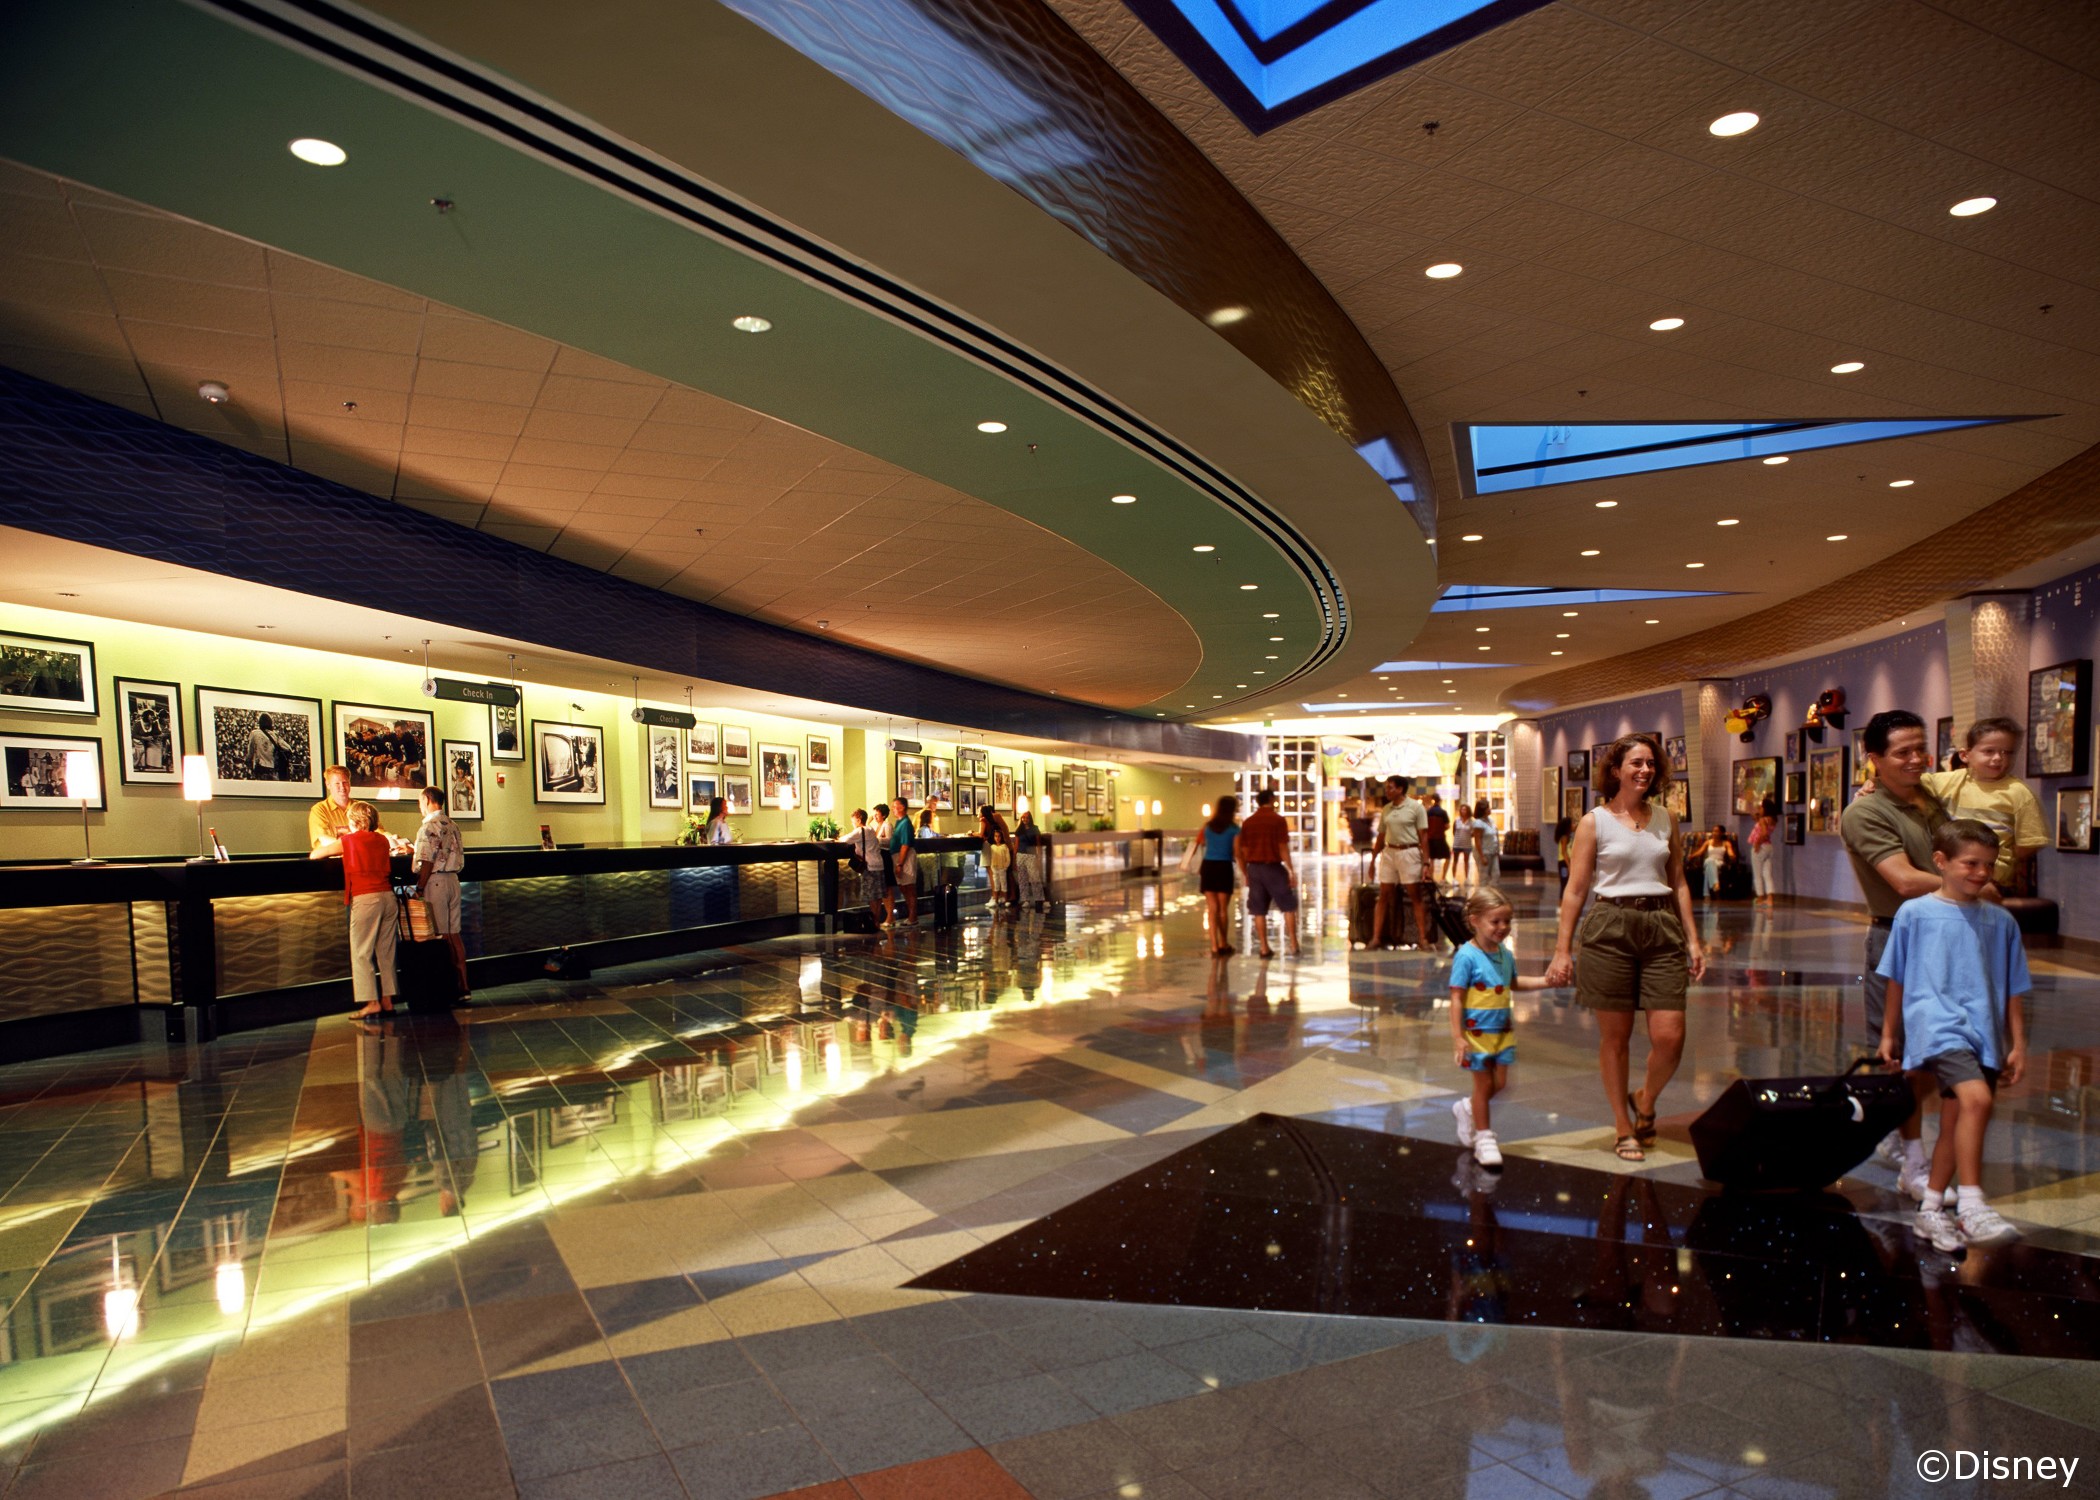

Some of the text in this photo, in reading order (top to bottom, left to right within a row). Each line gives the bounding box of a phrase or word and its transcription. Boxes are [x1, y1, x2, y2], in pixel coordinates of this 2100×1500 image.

[462, 687, 494, 700] Check In
[659, 714, 674, 723] Check
